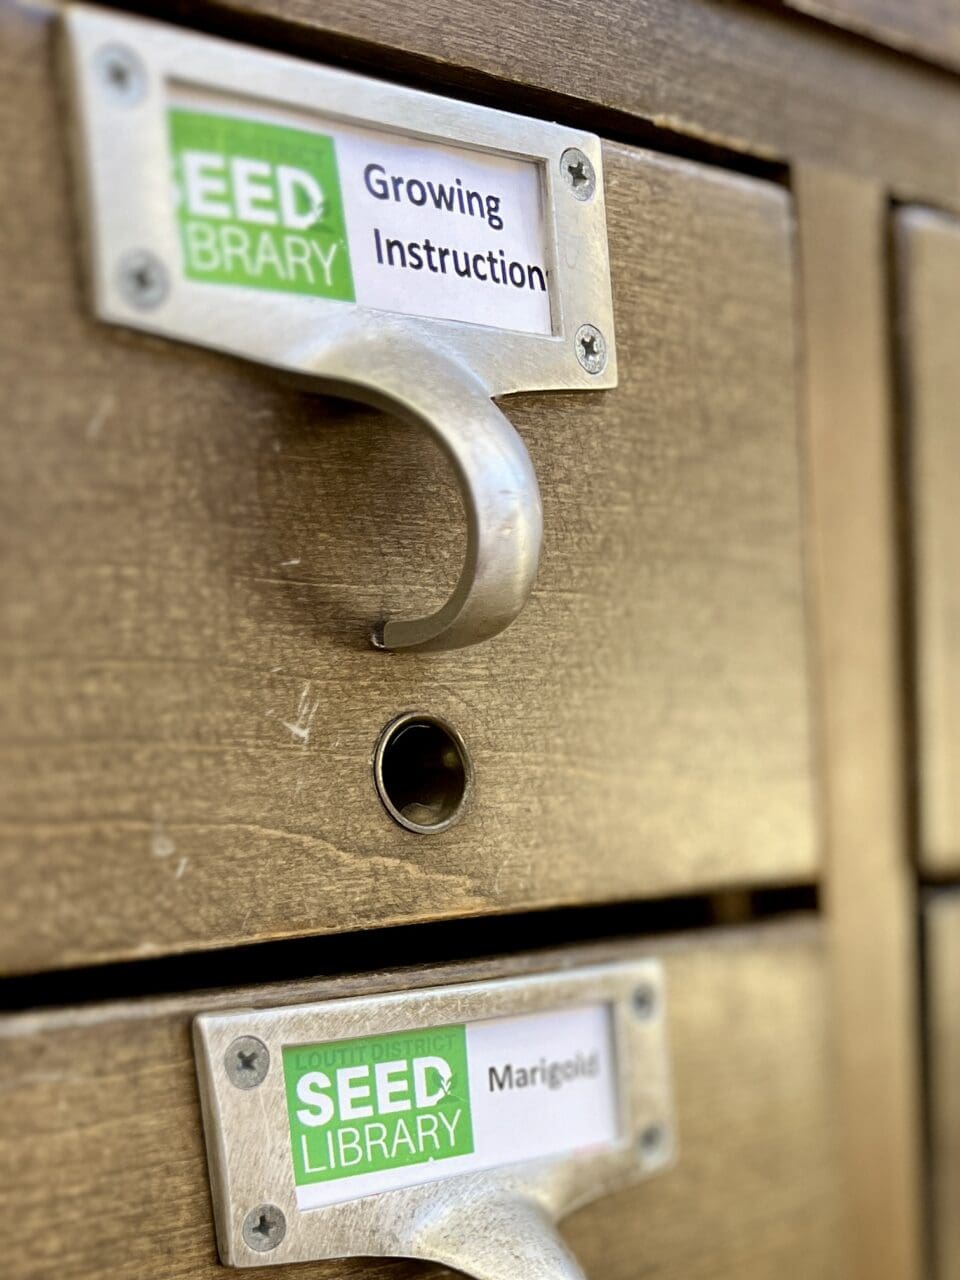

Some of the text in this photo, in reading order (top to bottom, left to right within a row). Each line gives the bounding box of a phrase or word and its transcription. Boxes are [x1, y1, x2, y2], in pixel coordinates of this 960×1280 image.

[172, 150, 325, 231] EED
[363, 163, 504, 231] Growing
[373, 228, 549, 291] Instruction
[371, 1033, 457, 1061] DISTRICT
[487, 1047, 600, 1093] Marigold
[296, 1055, 453, 1128] SEED
[301, 1108, 462, 1174] LIBRARY
